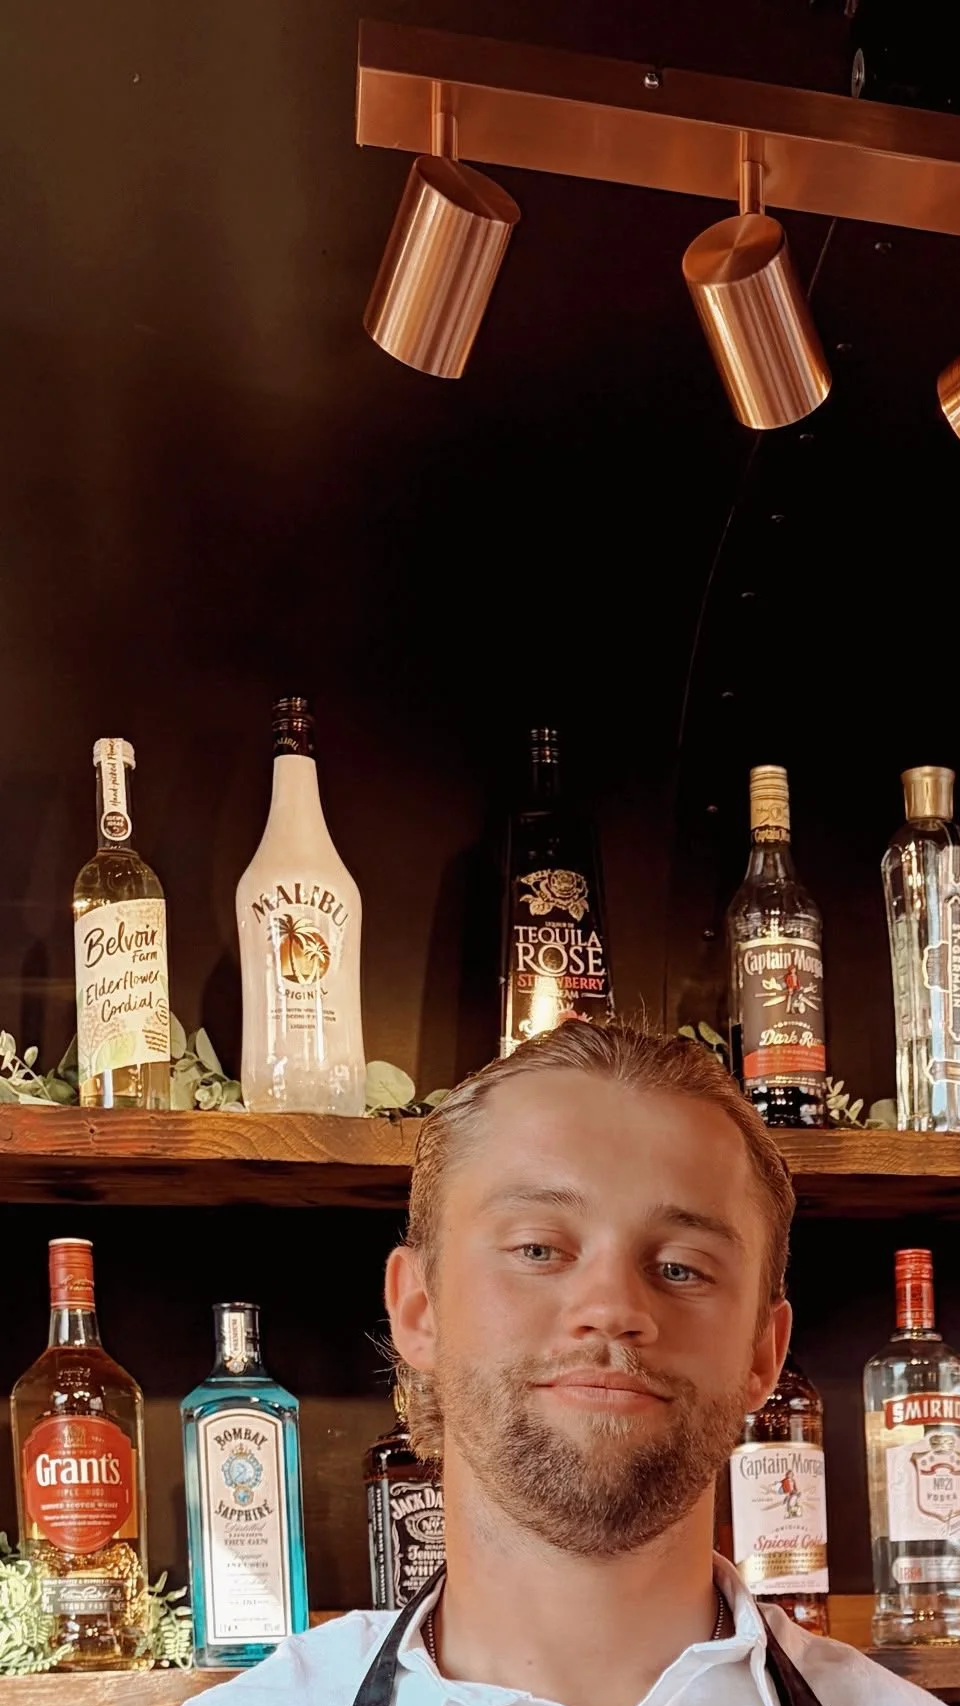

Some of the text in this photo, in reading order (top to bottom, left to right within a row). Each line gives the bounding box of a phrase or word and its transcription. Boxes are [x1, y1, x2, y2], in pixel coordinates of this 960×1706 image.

[251, 883, 349, 927] MALIBU
[84, 921, 160, 968] Belvoir
[514, 925, 601, 947] TEQUILA
[132, 949, 158, 963] Farm
[515, 942, 607, 977] ROSE
[743, 949, 823, 979] Captain Morga
[86, 970, 160, 1006] Elderflower
[276, 986, 328, 1001] RIGINL
[517, 974, 605, 990] STWBERRY
[101, 992, 153, 1023] Cordial
[759, 1029, 798, 1046] Dark
[213, 1427, 268, 1451] BOMBAY
[35, 1453, 121, 1487] Grant's
[740, 1454, 788, 1480] Captain
[214, 1500, 273, 1522] SAPPHIRE
[390, 1492, 425, 1520] JACK
[753, 1535, 798, 1552] Spiced
